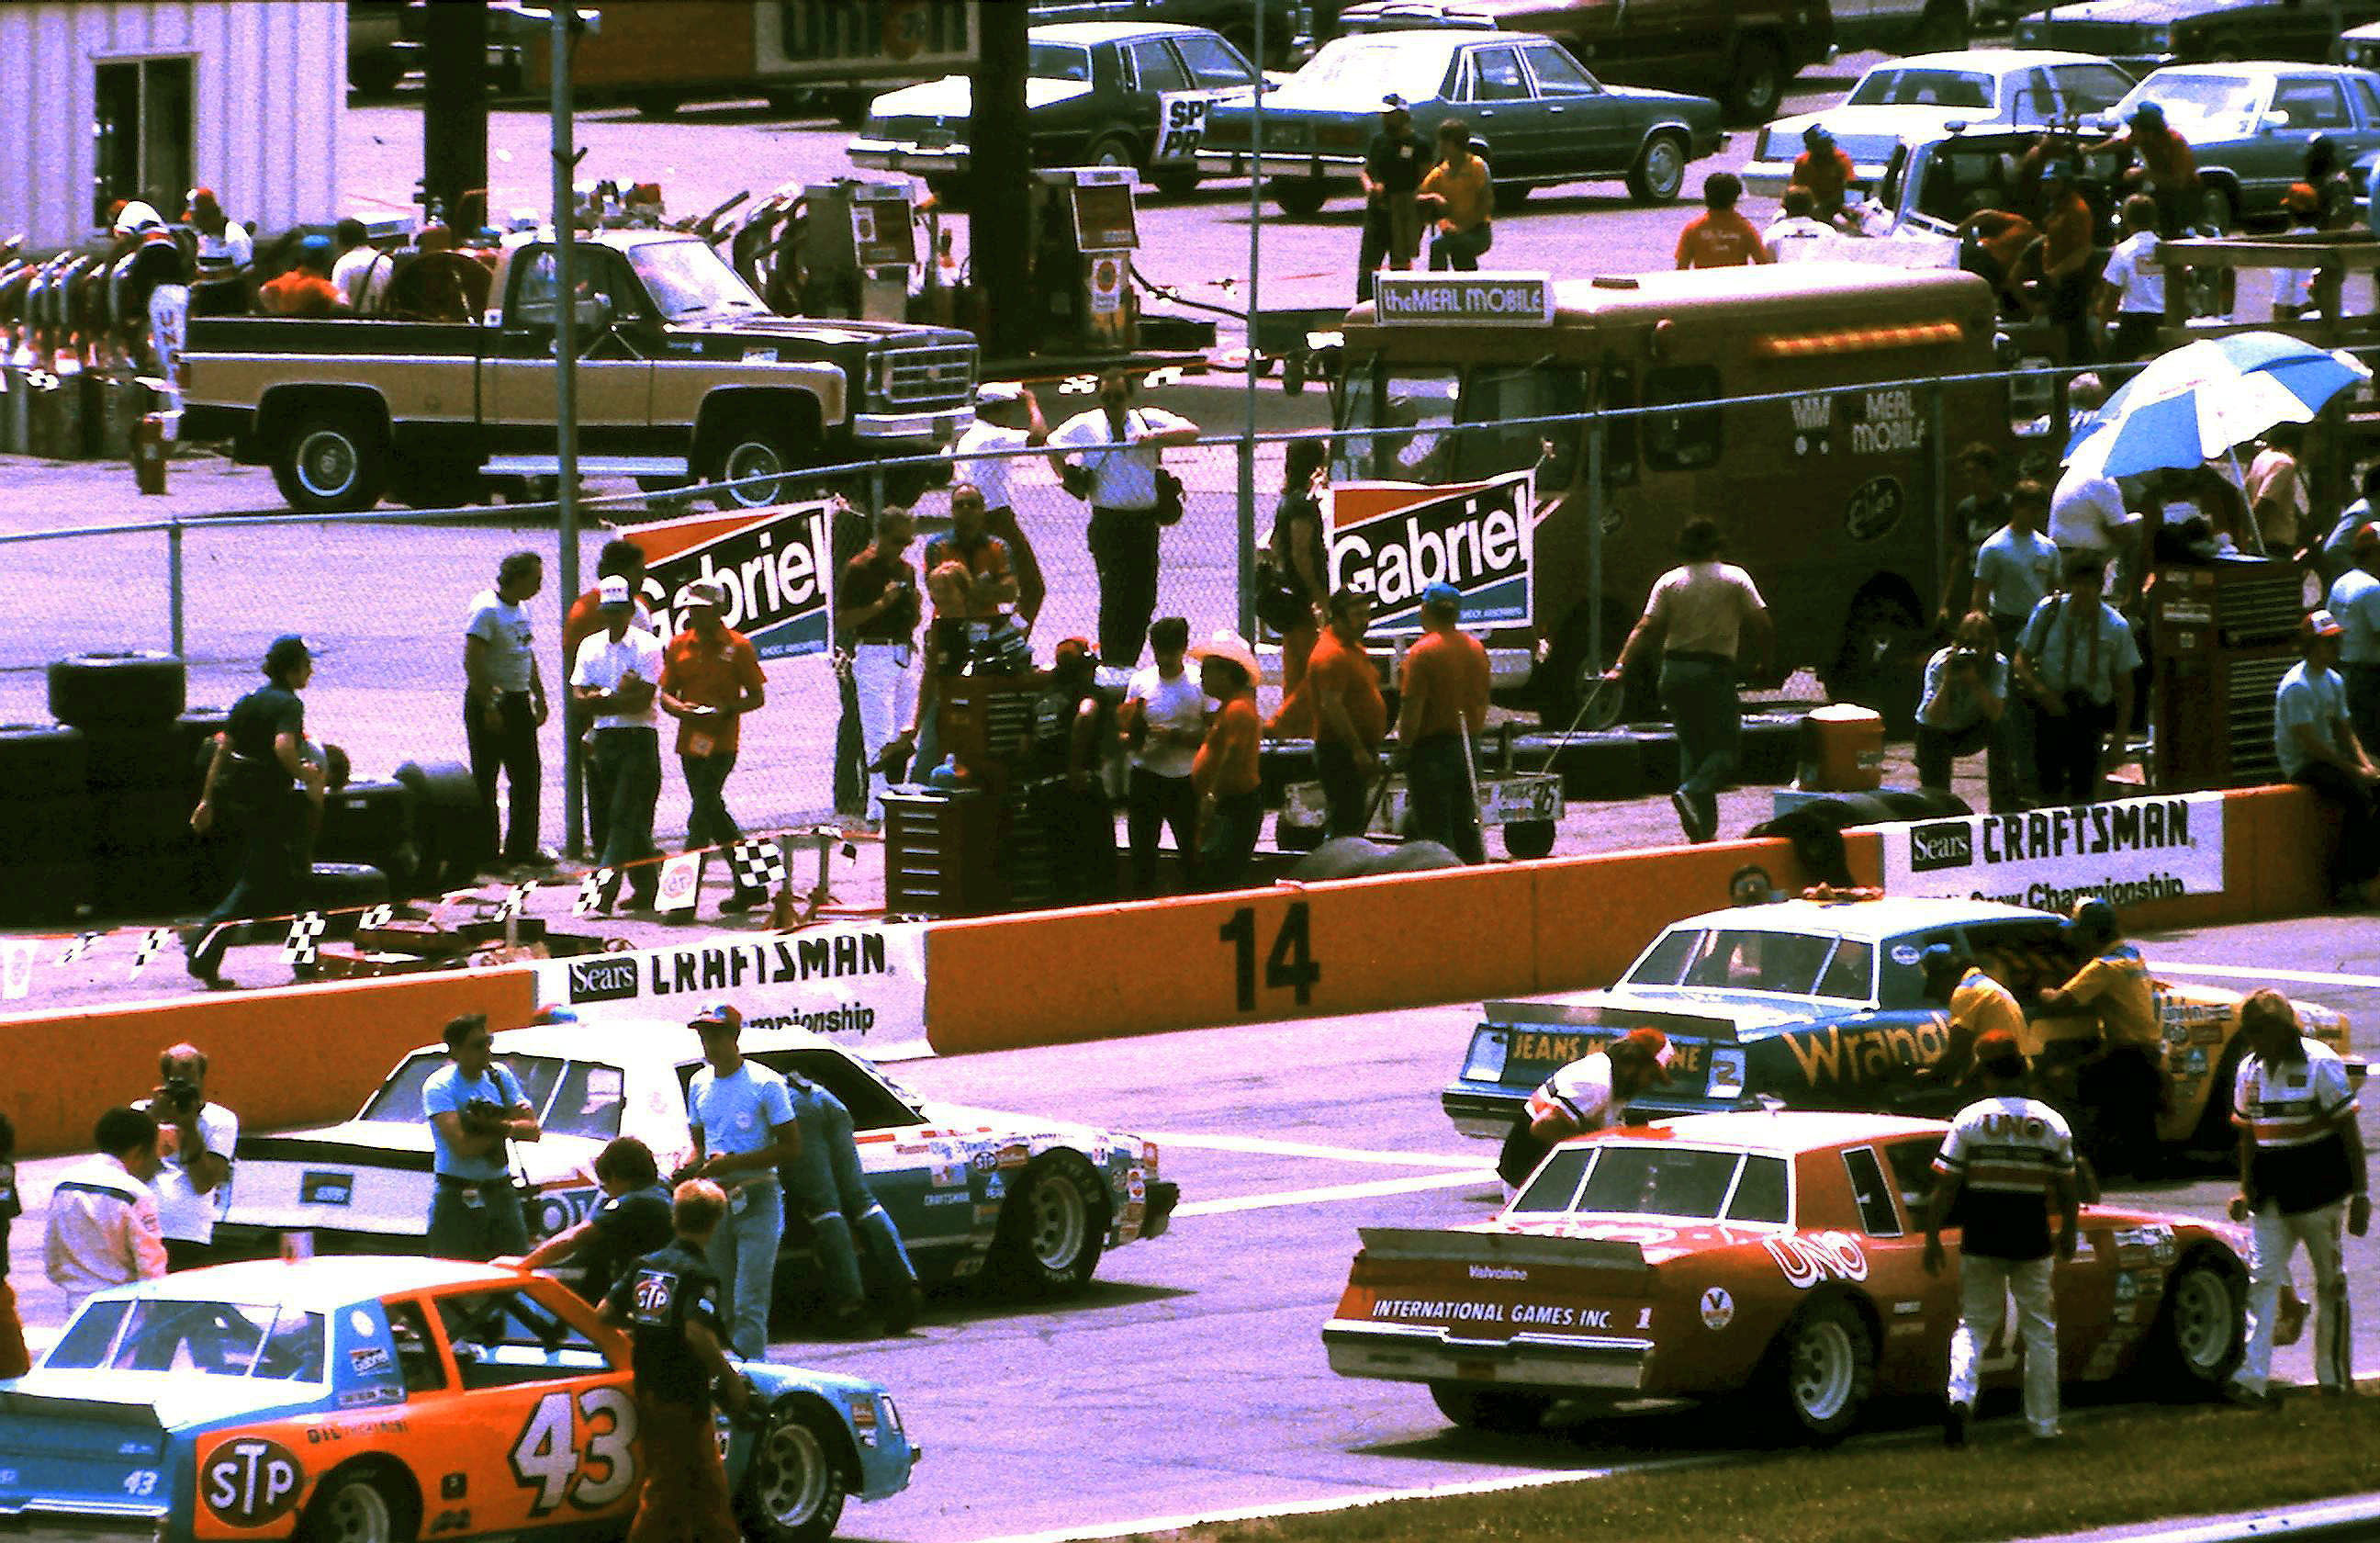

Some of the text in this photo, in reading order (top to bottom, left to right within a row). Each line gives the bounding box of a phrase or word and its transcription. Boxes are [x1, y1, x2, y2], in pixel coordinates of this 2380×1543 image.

[1466, 287, 1544, 312] MOBILE
[1332, 484, 1527, 604] Gabriel
[1914, 799, 2189, 864] Sears CRAFTSMAN
[1219, 902, 1320, 1012] 14
[573, 963, 634, 994] Sears
[1514, 1034, 1580, 1061] JEANS
[1712, 1060, 1742, 1087] 2
[1469, 1264, 1529, 1281] Valvoline
[1763, 1231, 1869, 1289] UNO
[638, 1282, 668, 1312] STP
[1373, 1300, 1651, 1329] INTERNATIONAL GAMES INC. 1
[307, 1429, 342, 1444] OIL
[509, 1385, 640, 1517] 43
[123, 1470, 158, 1496] 43
[210, 1443, 295, 1516] STP
